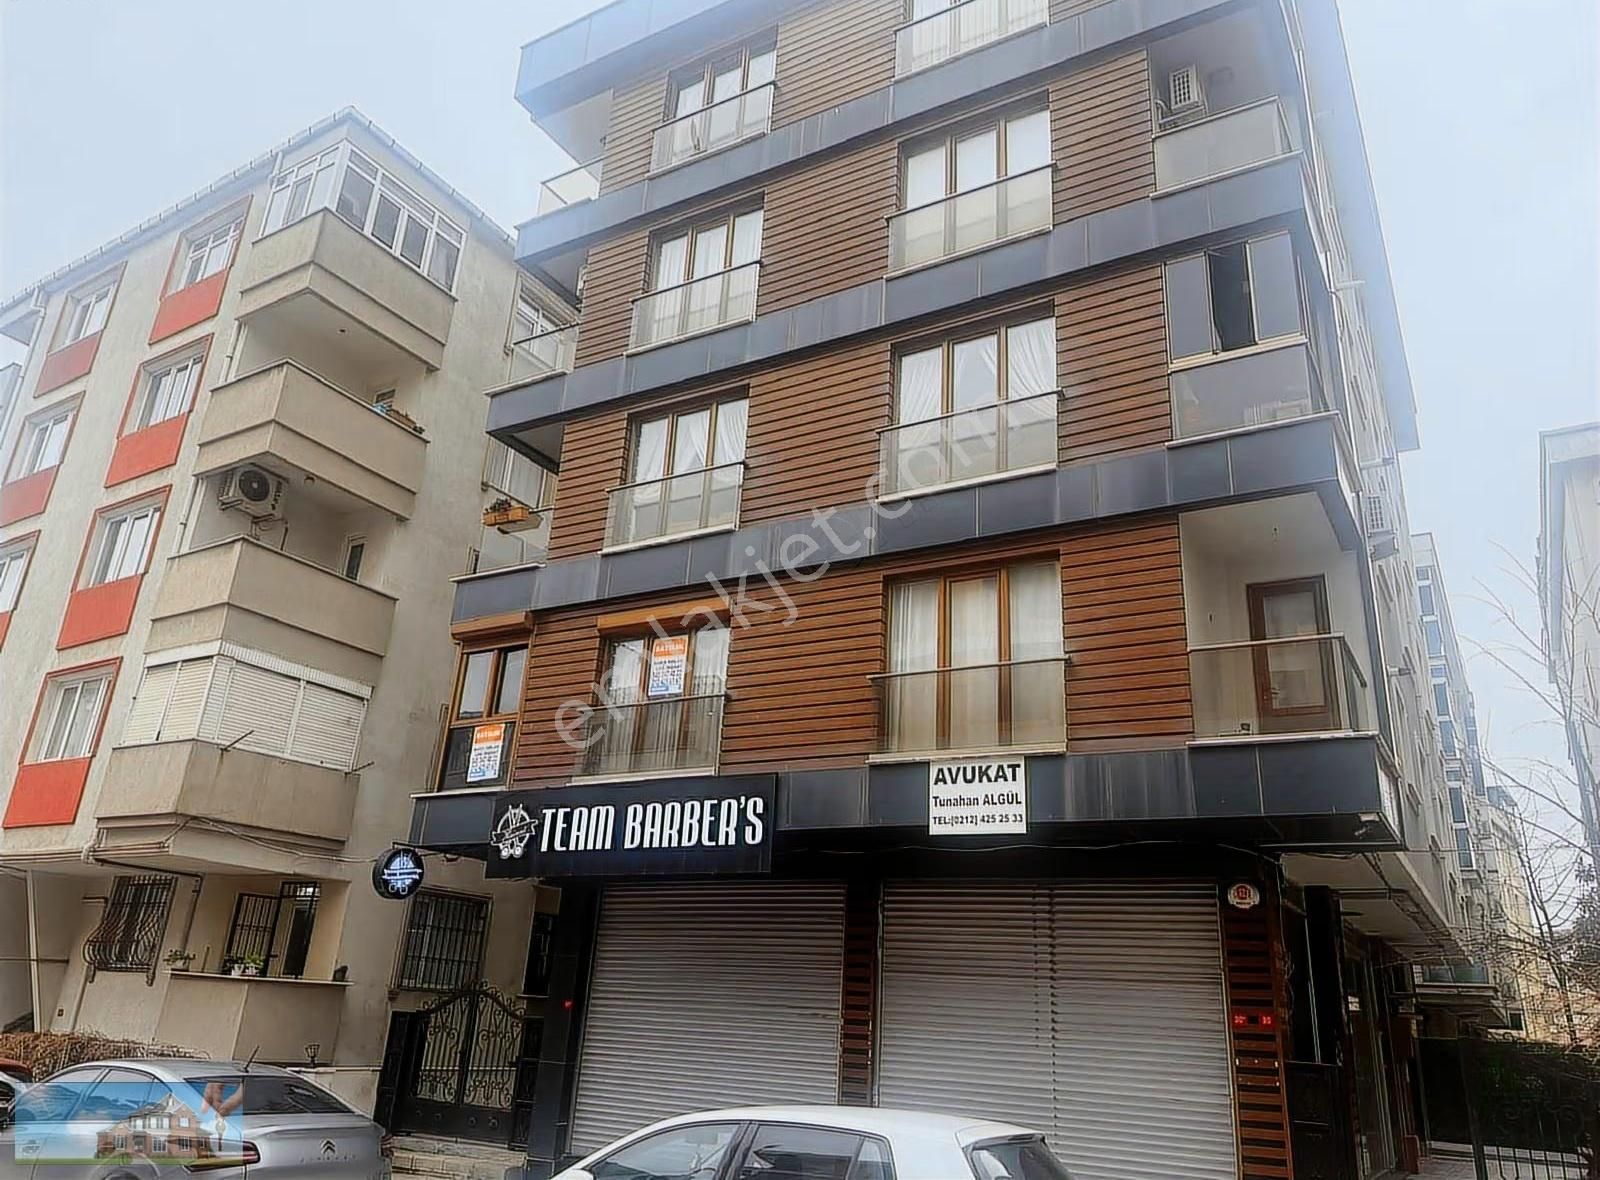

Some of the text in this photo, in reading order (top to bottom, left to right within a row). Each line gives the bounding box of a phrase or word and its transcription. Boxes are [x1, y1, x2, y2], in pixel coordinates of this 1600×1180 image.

[934, 764, 1021, 785] AVUKAT
[932, 791, 1022, 807] Tunahan ALGÜL
[540, 797, 763, 851] TEAM BARBER'S
[980, 814, 996, 824] 425
[998, 814, 1010, 823] 25
[1012, 813, 1023, 823] 33
